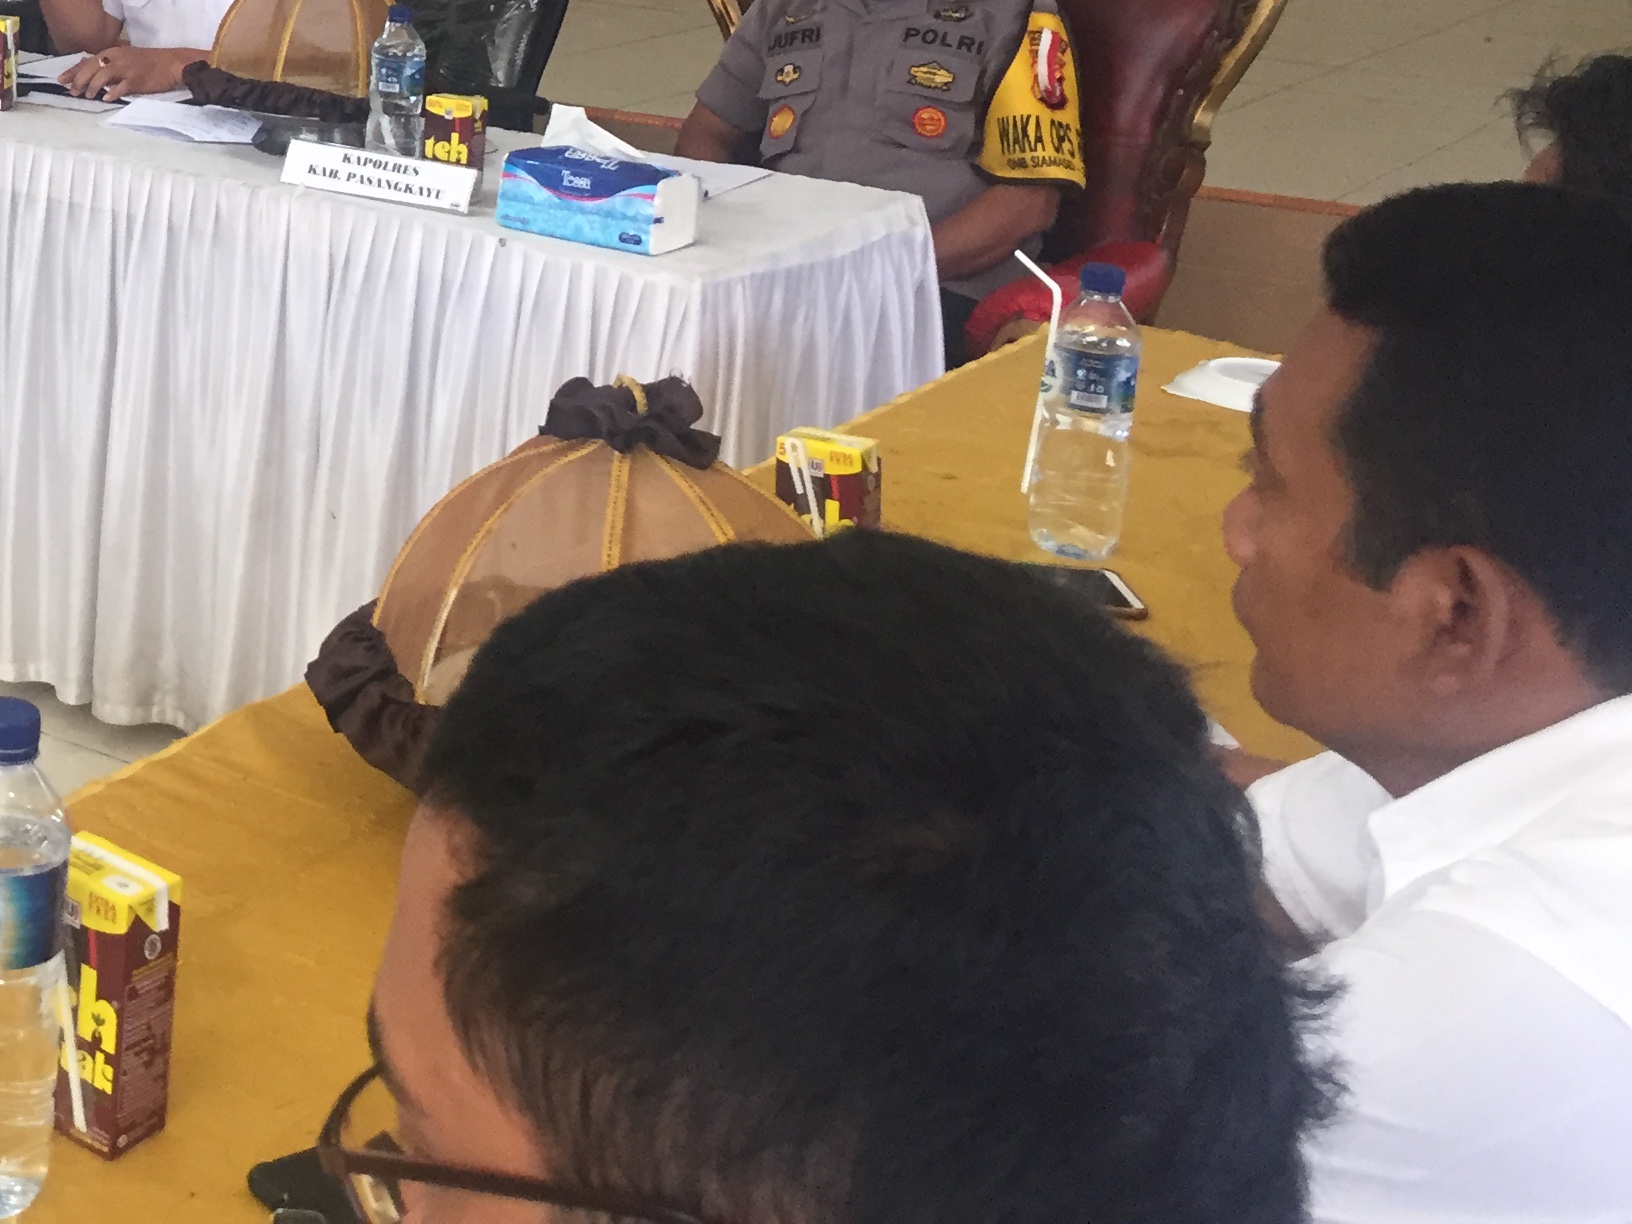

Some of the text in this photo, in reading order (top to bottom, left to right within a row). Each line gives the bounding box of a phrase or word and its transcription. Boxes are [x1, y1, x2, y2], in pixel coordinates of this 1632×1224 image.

[902, 27, 985, 56] POLRI
[425, 132, 468, 165] teh
[997, 114, 1046, 156] WAKA
[342, 153, 420, 176] KAPOLRES
[307, 164, 445, 200] KAB. PASANGKAYU
